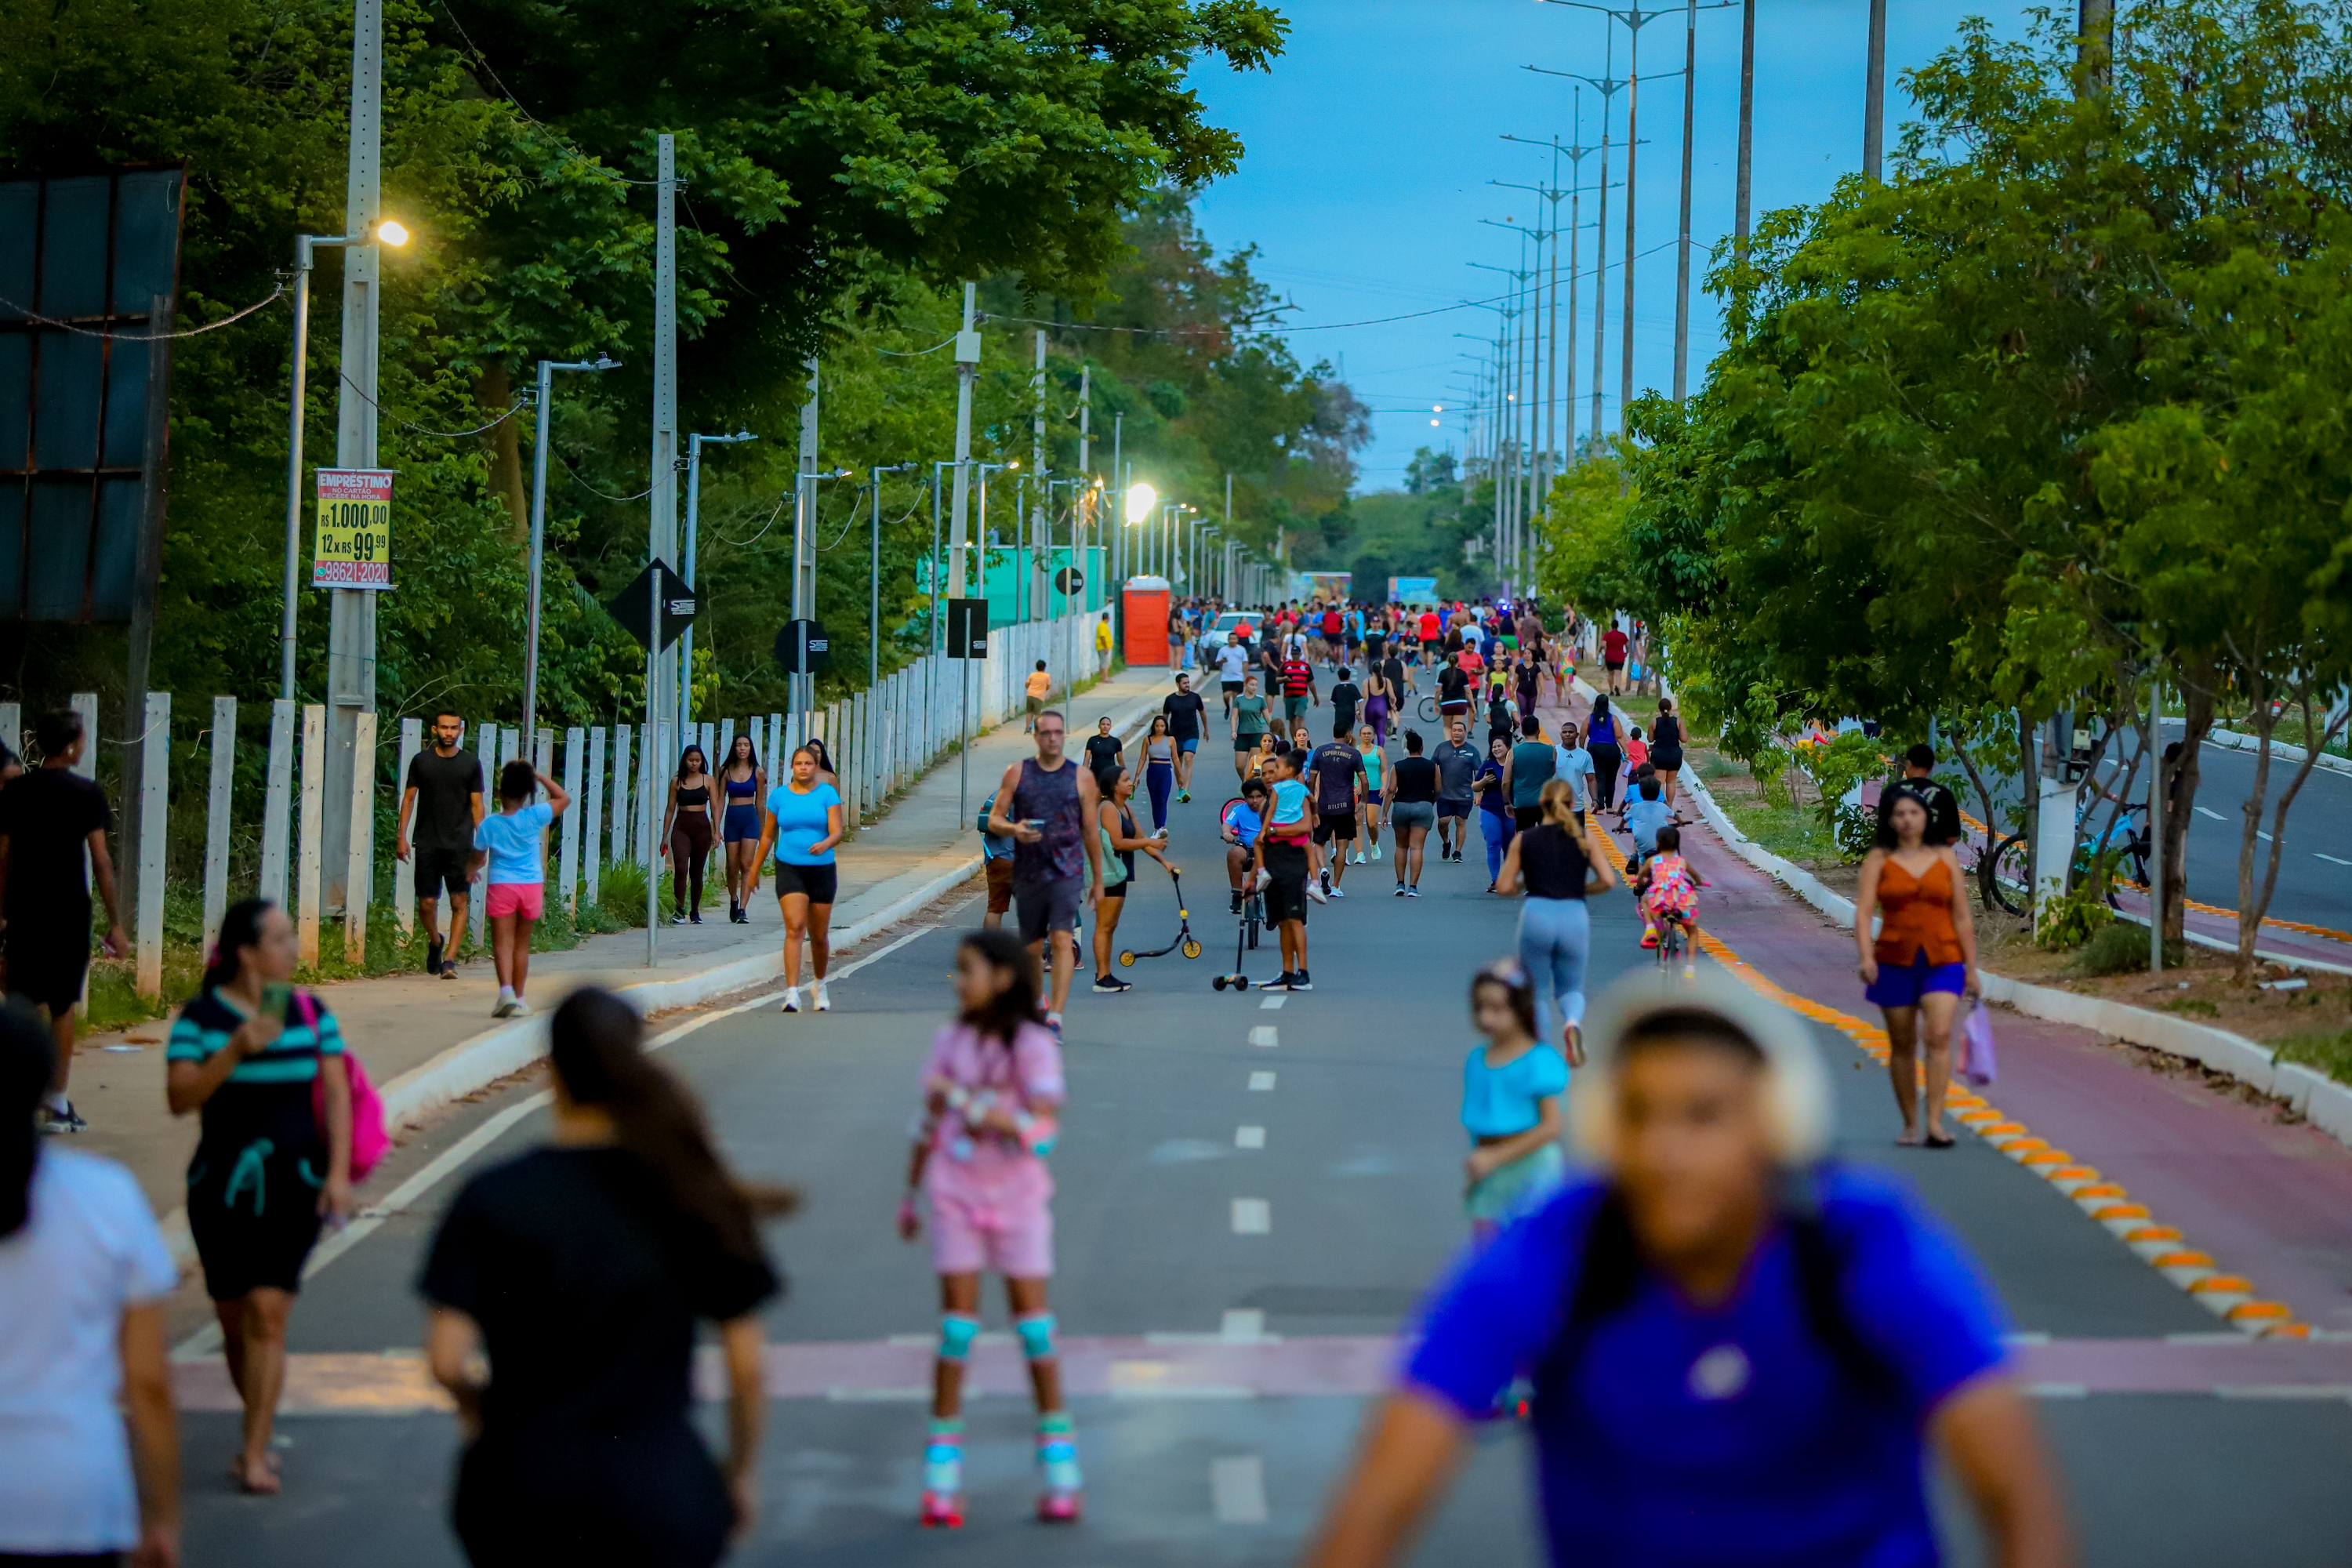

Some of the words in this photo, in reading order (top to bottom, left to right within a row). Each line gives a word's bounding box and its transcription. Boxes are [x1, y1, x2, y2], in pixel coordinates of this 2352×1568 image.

[320, 473, 391, 488] EMPRÉSTIMO
[321, 514, 329, 528] R$
[331, 503, 387, 529] 1.000,00
[322, 534, 333, 553] 12
[342, 542, 351, 554] R$
[325, 561, 388, 583] 98621-2020
